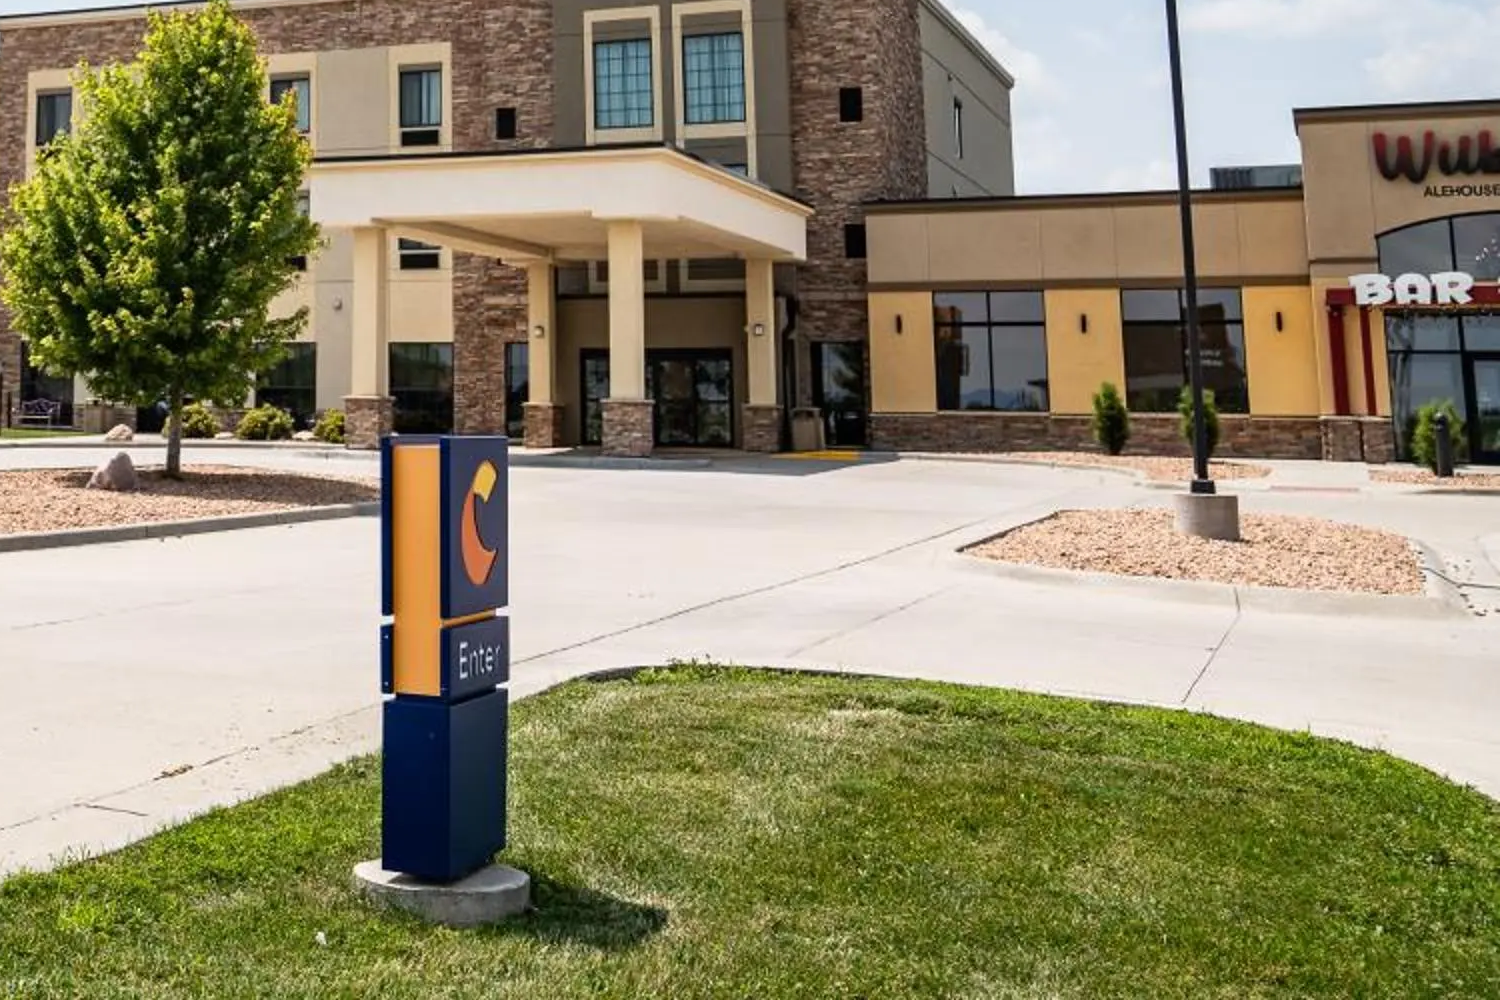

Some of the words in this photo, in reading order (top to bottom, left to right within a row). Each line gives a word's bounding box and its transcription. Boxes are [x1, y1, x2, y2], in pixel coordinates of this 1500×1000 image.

[1424, 183, 1500, 198] ALEHOUSE
[1348, 271, 1474, 306] BAR
[459, 640, 501, 681] Enter
